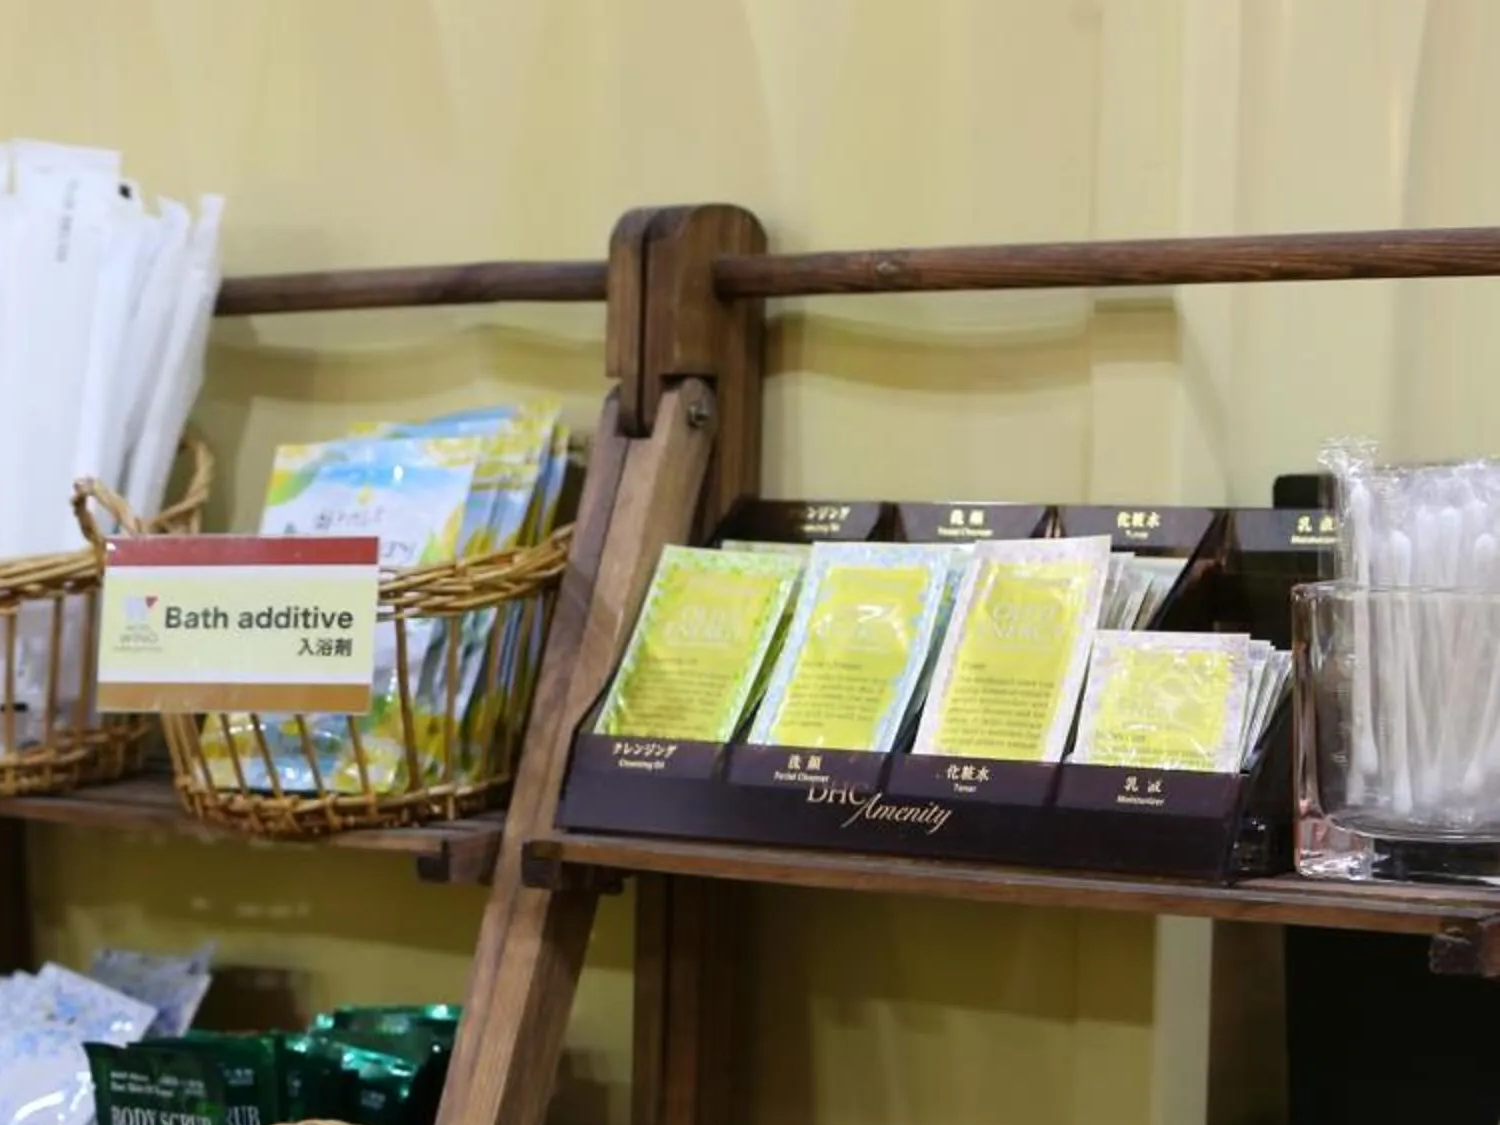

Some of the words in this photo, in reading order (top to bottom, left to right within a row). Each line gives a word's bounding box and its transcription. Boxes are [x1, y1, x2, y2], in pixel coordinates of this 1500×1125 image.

[164, 605, 229, 630] Bath
[236, 605, 355, 630] additive
[297, 637, 353, 658] 入浴剤
[946, 763, 991, 783] 化粧水
[806, 778, 868, 805] DHC
